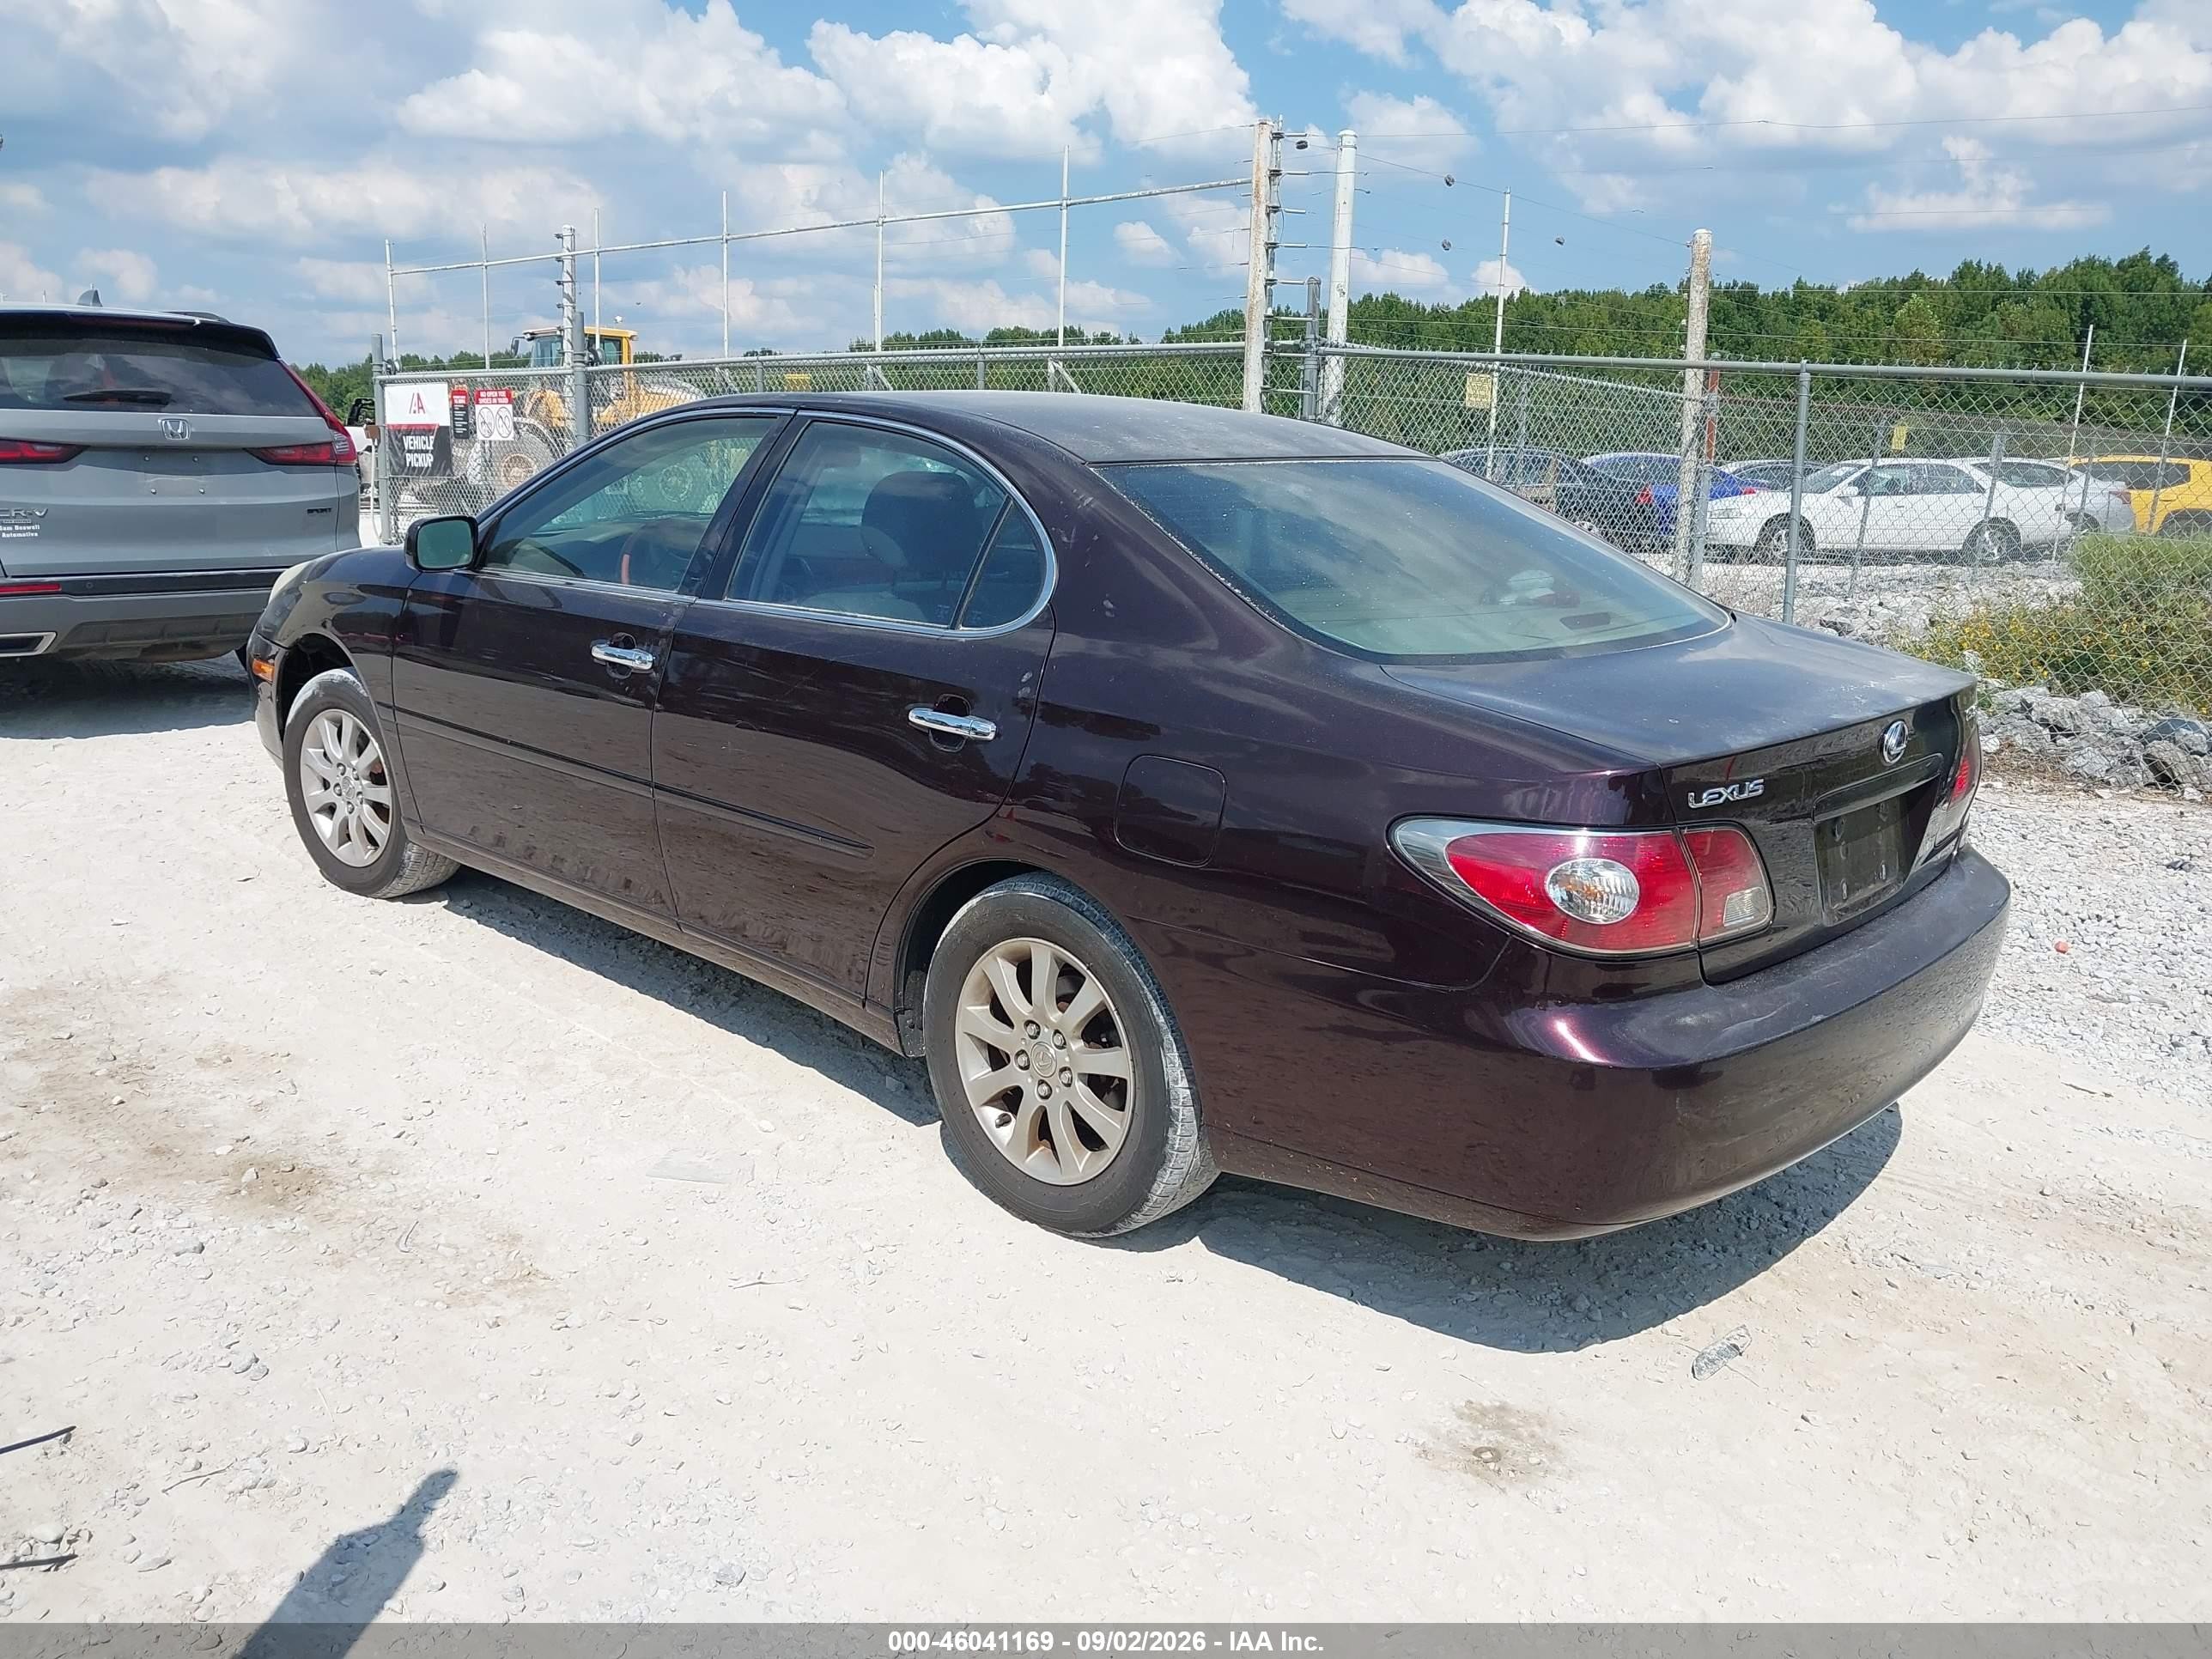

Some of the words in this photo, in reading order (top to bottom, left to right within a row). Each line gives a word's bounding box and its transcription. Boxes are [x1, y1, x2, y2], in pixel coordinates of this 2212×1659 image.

[403, 435, 434, 450] VEHICLE
[405, 453, 434, 467] PICKUP
[1687, 778, 1765, 809] LEXUS
